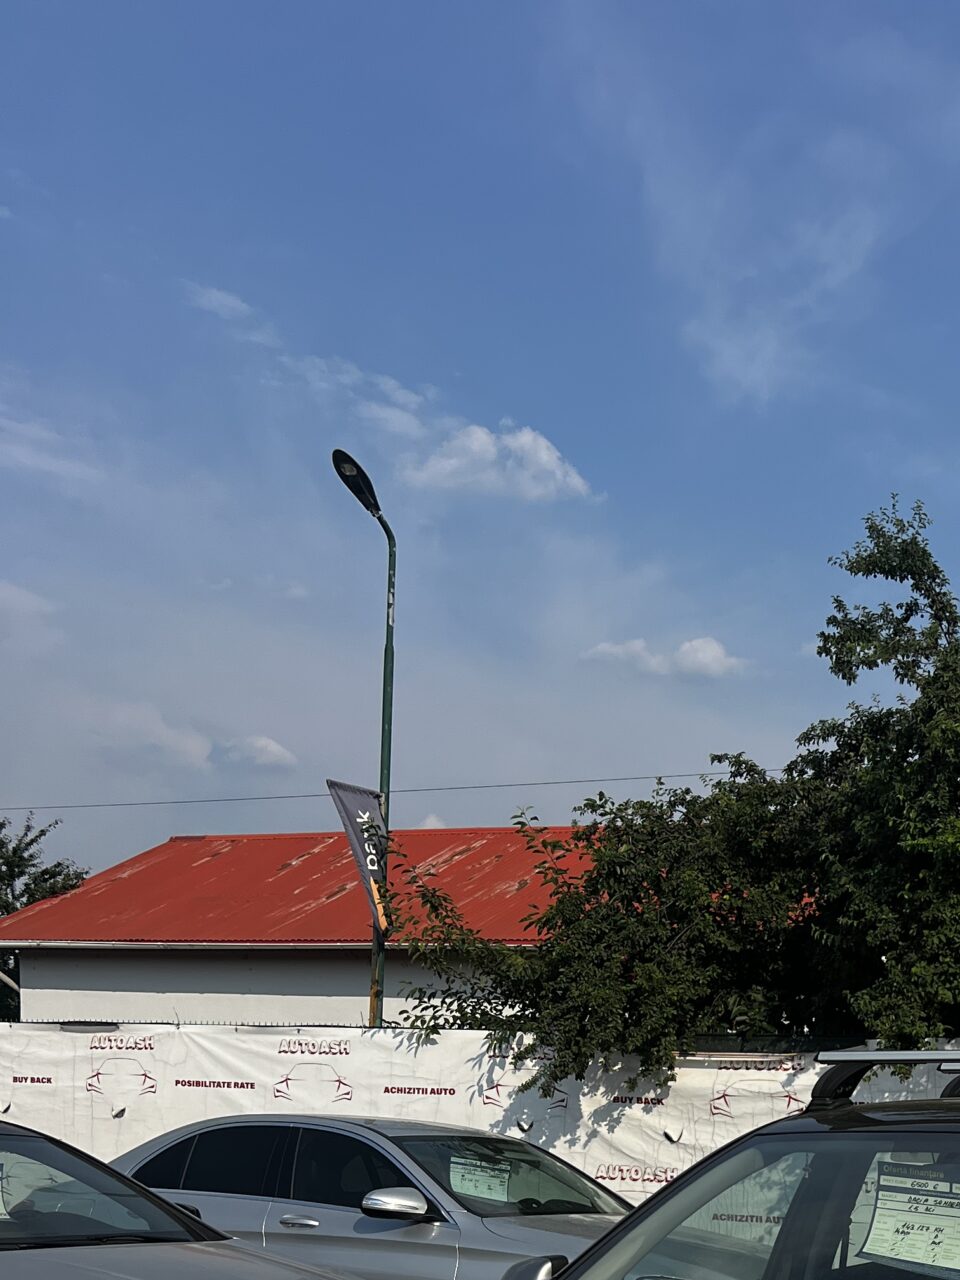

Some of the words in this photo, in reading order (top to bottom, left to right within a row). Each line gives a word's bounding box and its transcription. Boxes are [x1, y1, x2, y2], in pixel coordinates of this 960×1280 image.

[90, 1035, 155, 1051] AUTOASH
[278, 1039, 351, 1055] AUTOASH
[12, 1076, 29, 1084] BUY
[30, 1076, 52, 1085] BACK
[175, 1079, 232, 1089] POSIBILITATE
[233, 1081, 256, 1090] RATE
[383, 1086, 428, 1096] ACHIZITII
[430, 1088, 456, 1096] AUTO
[612, 1096, 634, 1105] BUY
[636, 1096, 665, 1106] BACK
[911, 1180, 929, 1189] 6500
[712, 1213, 763, 1223] ACHIZITII
